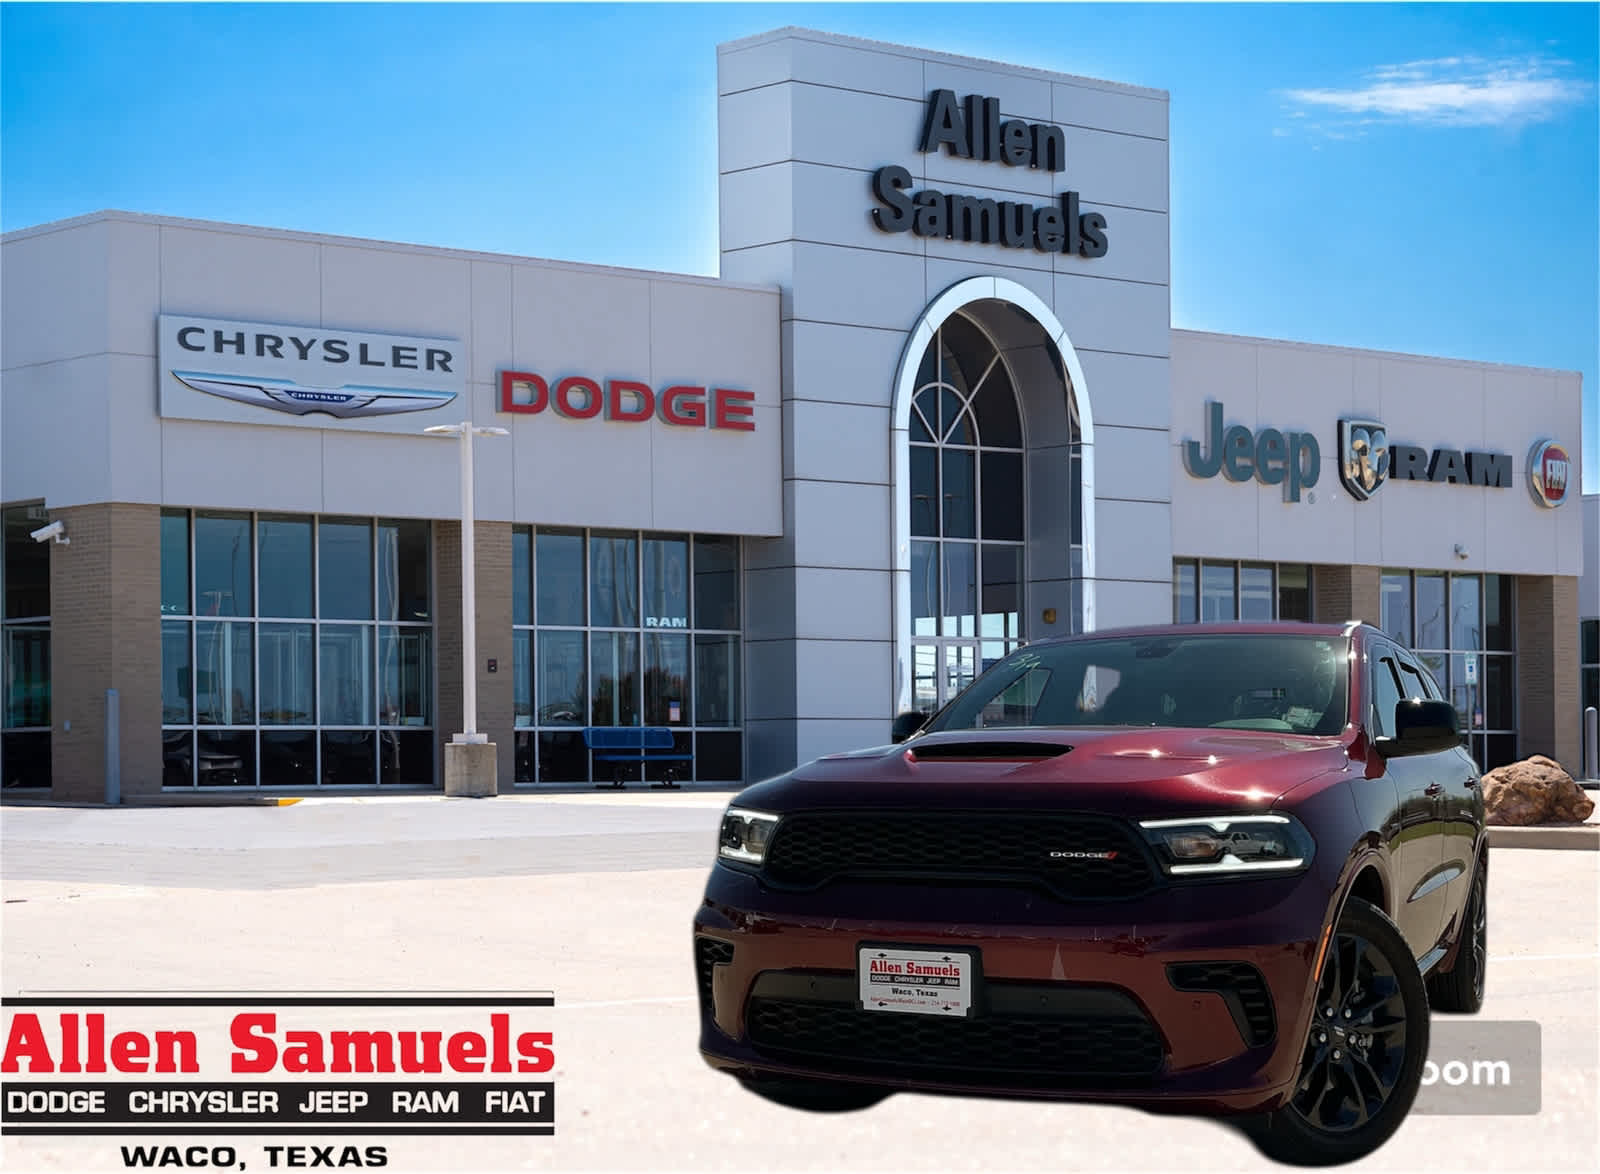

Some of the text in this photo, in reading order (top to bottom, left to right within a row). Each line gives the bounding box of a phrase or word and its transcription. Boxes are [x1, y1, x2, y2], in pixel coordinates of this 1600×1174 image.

[918, 88, 1066, 172] Allen
[871, 165, 1108, 258] Samuels
[176, 326, 454, 373] CHRYSLER
[289, 391, 347, 401] CHRYSLER
[496, 370, 756, 432] DODGE
[1182, 400, 1321, 503] Jeep
[1388, 444, 1513, 489] RAM
[645, 616, 687, 628] RAM
[870, 960, 960, 977] Allen Samuels
[871, 974, 891, 982] DODGE
[894, 976, 924, 984] CHRYSLER
[891, 988, 938, 998] Waco, Texas
